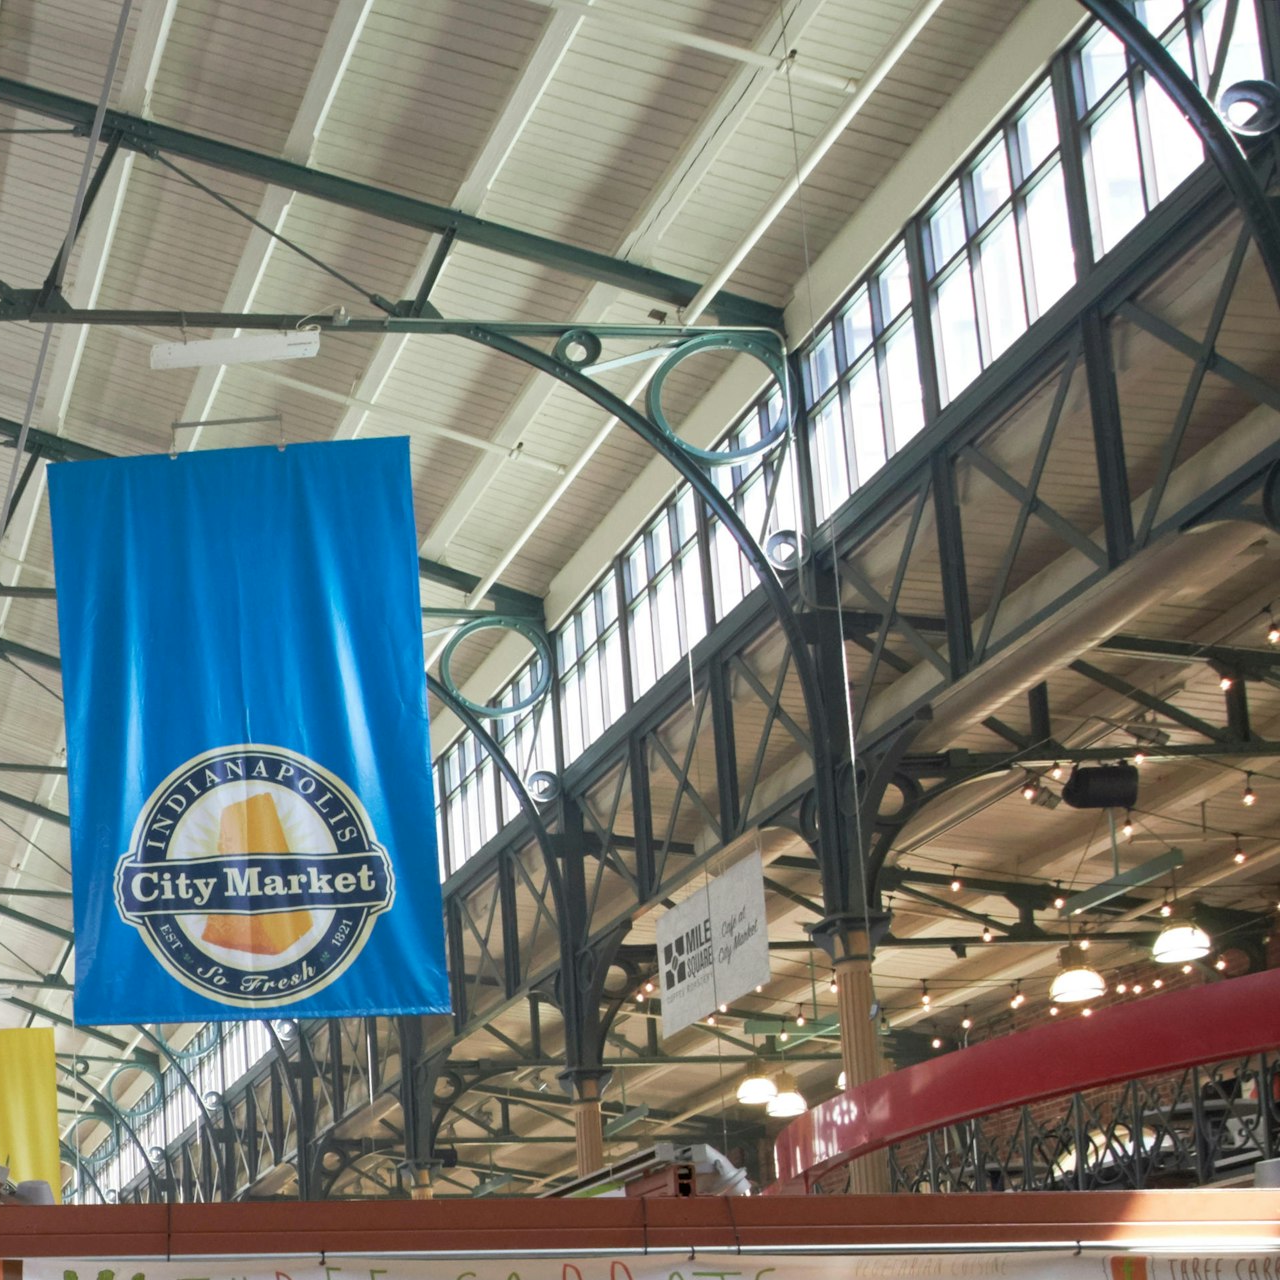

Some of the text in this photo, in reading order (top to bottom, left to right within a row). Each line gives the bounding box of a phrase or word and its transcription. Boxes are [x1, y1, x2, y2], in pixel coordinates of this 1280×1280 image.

[146, 758, 358, 852] INDIANAPOLIS
[131, 864, 376, 905] City Market
[159, 922, 183, 952] EST
[331, 918, 354, 948] 1821
[685, 917, 712, 955] MILE
[196, 961, 318, 994] So Fresh
[687, 945, 714, 980] SQUARE
